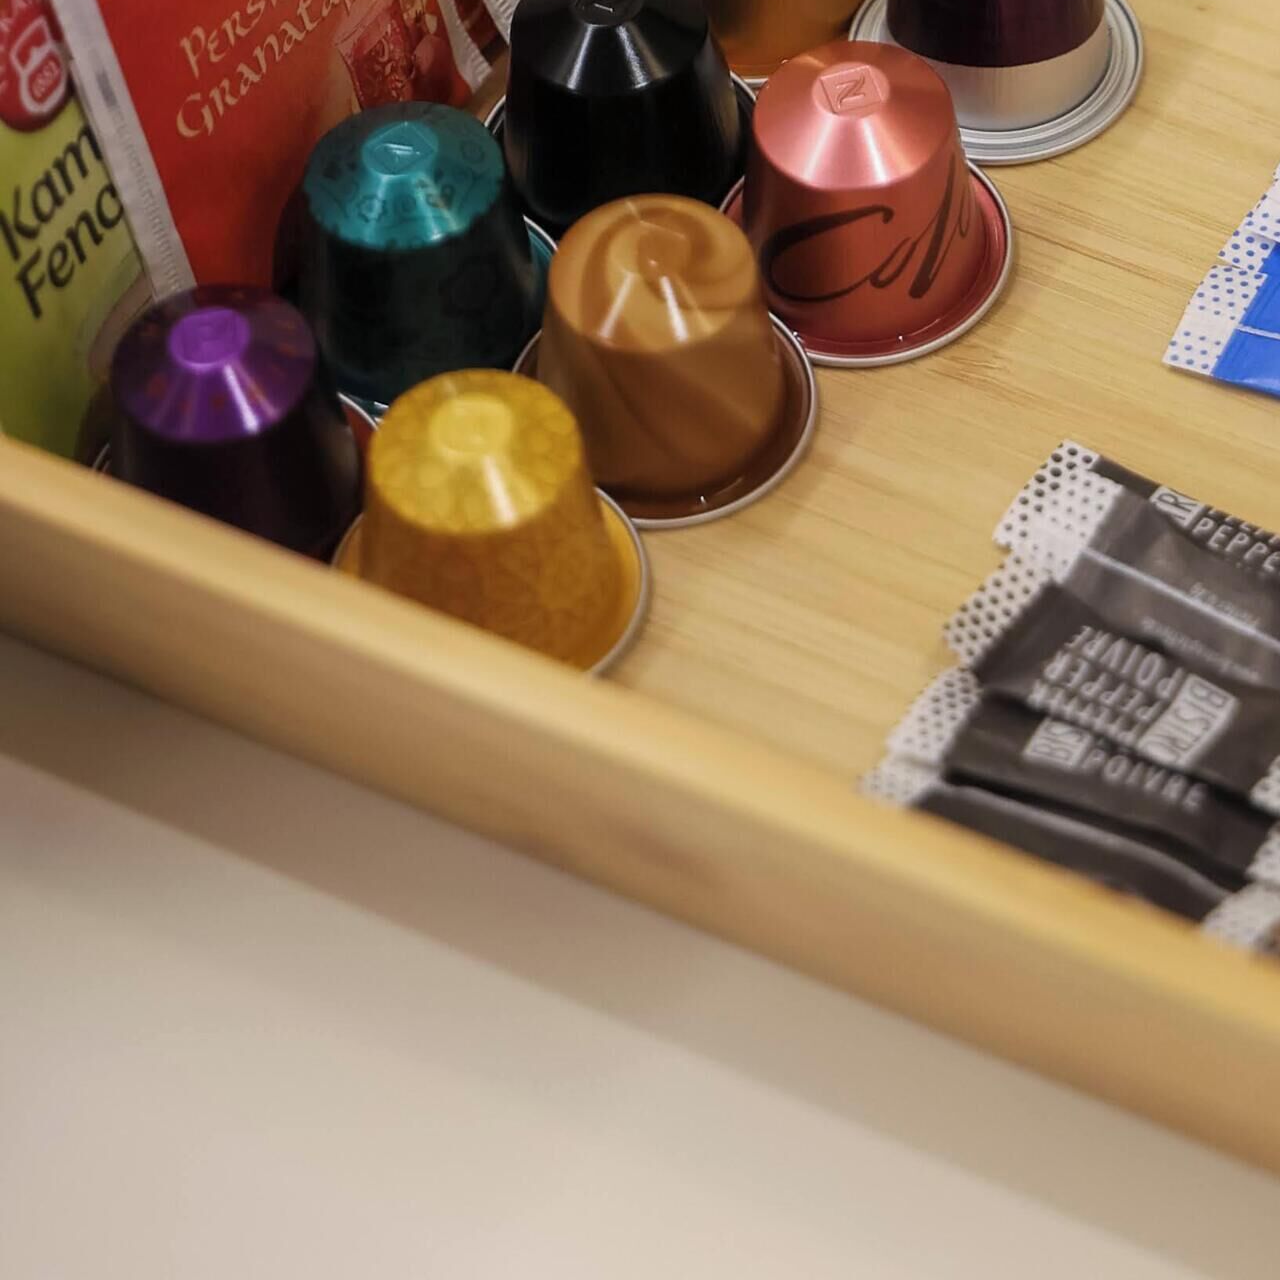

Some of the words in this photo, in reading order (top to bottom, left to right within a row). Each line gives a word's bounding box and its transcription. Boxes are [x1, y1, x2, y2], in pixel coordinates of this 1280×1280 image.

[1042, 650, 1164, 724] PEPPER
[1063, 624, 1187, 700] POIVRE
[1081, 748, 1208, 814] POIVRE
